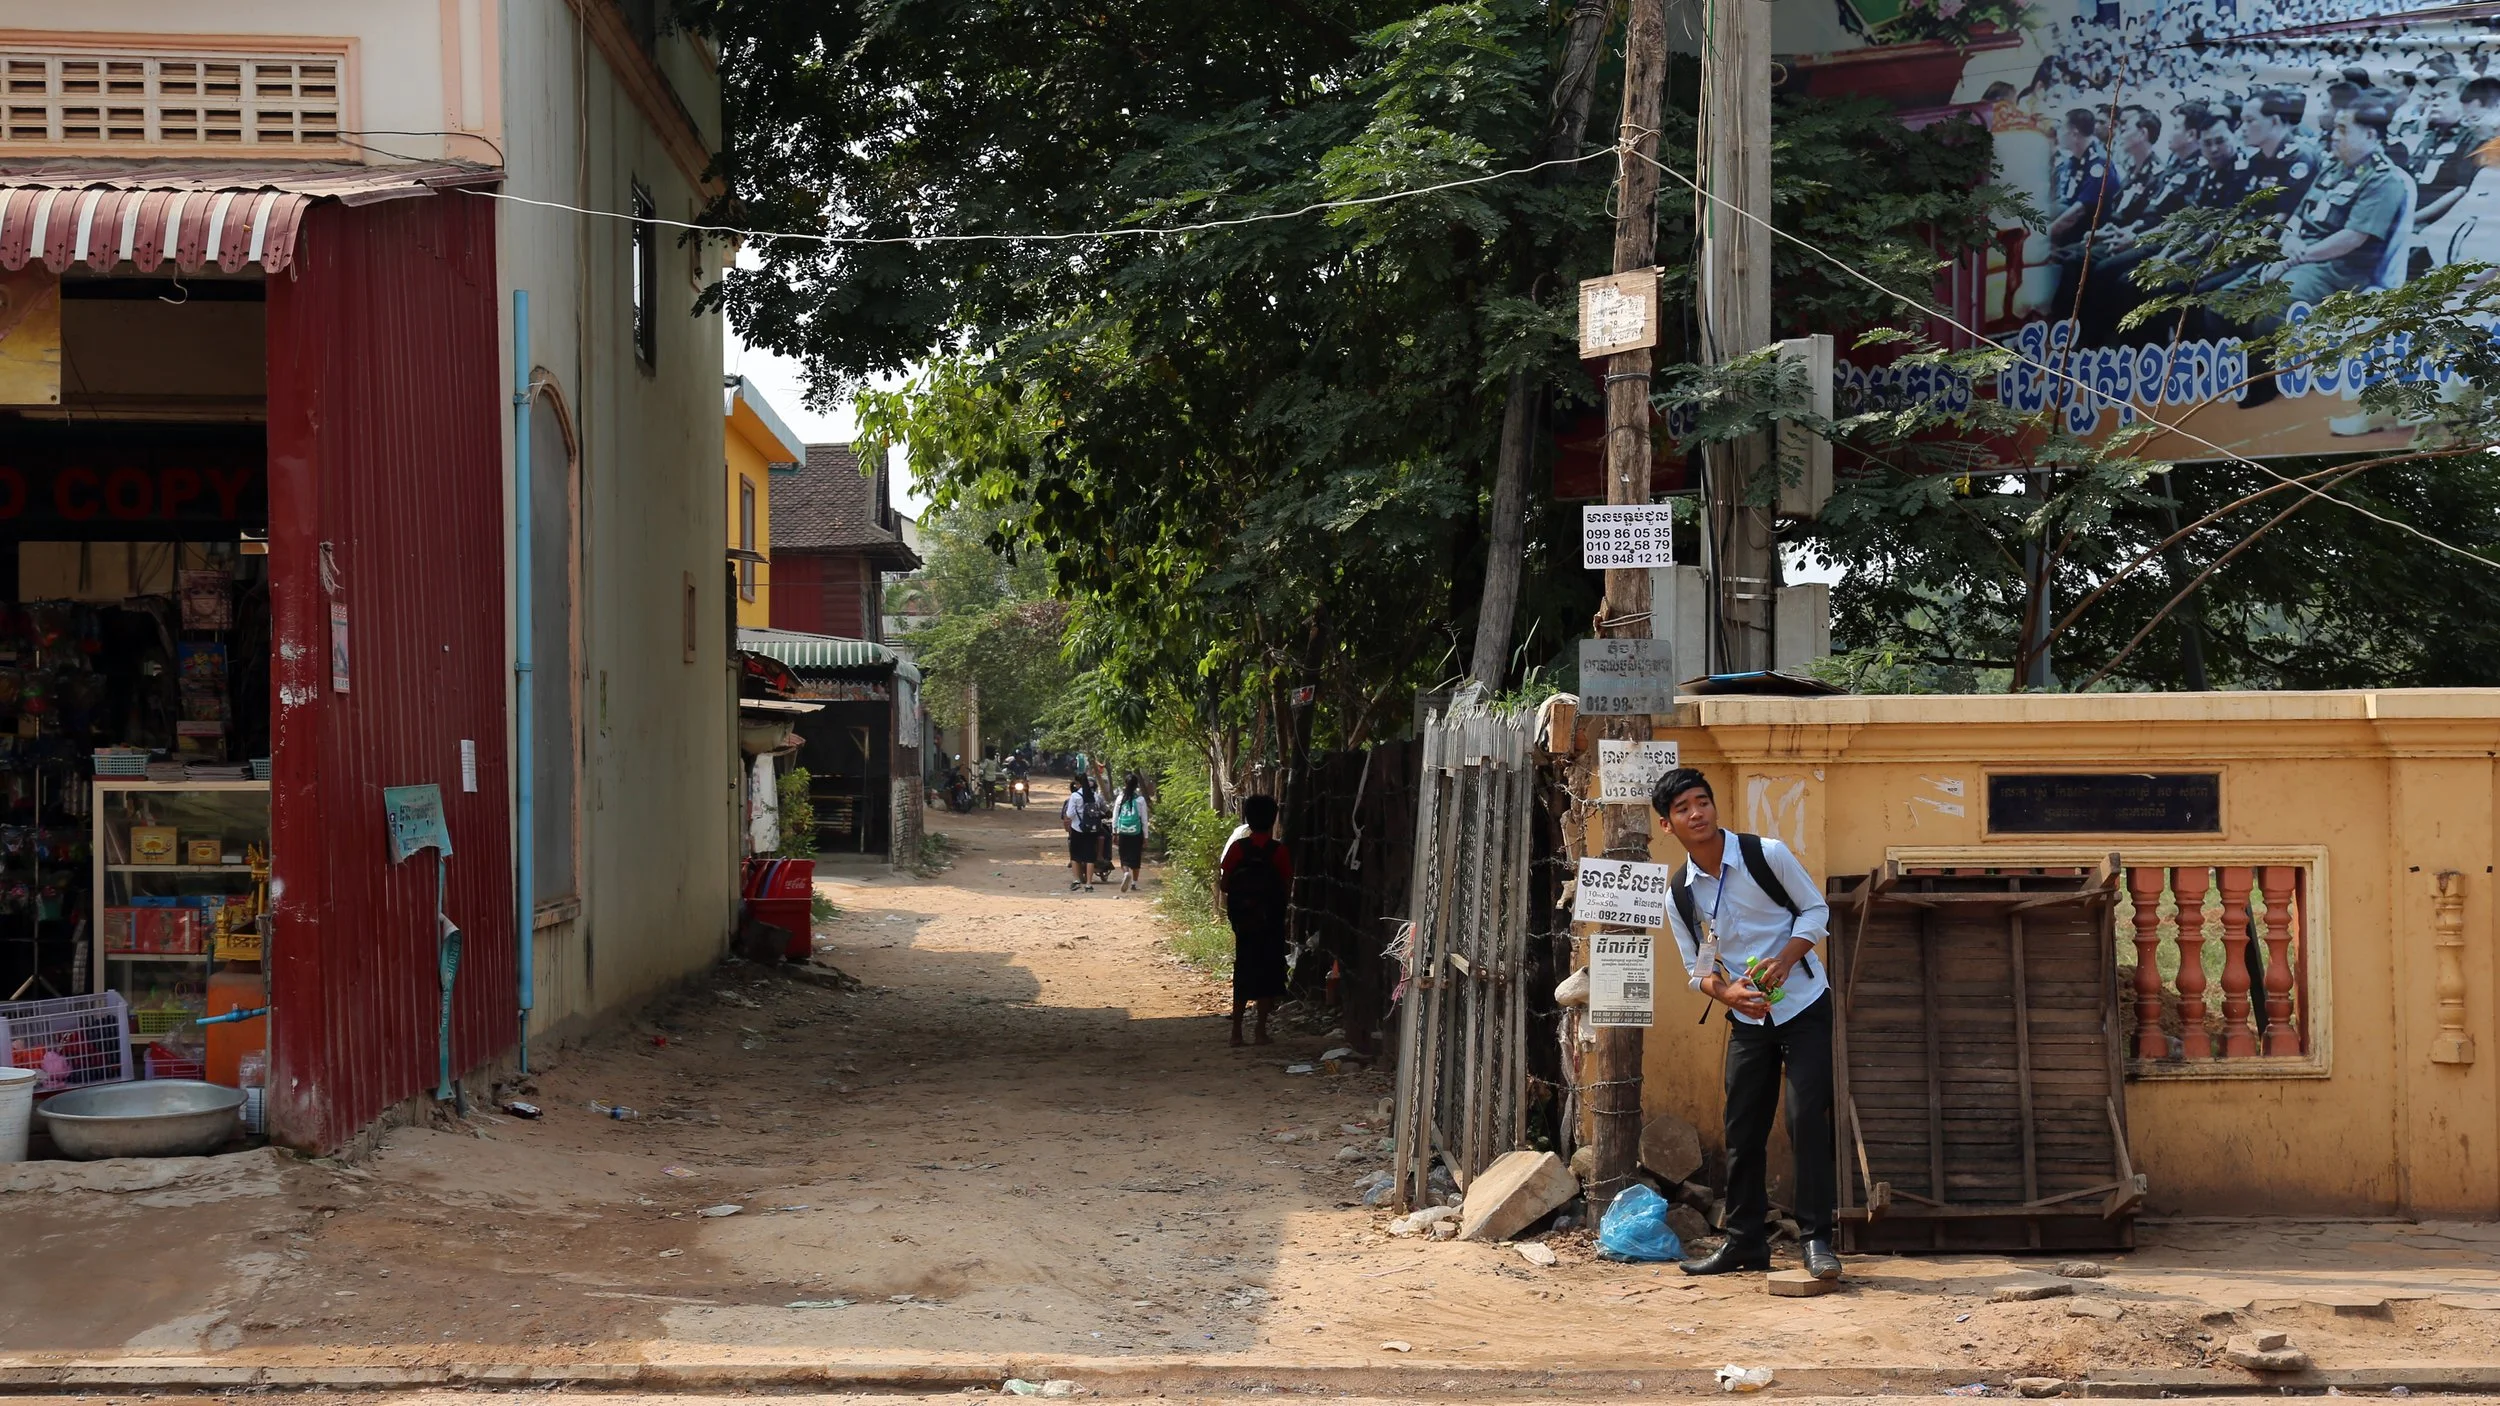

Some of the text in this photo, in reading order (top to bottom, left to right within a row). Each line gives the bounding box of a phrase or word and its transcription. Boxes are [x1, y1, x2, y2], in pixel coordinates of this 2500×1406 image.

[53, 466, 253, 521] COPY
[1586, 506, 1669, 526] មានបន្ទប់ជួល
[1586, 527, 1670, 539] 099 86 05 35
[1586, 539, 1670, 551] 010 22 58 79
[1586, 552, 1670, 564] 088 948 12 12
[1586, 696, 1608, 712] 012
[1630, 786, 1645, 797] 64
[1581, 863, 1665, 895] មានដីលក់
[1579, 909, 1661, 926] Tel: 092 27 69 95
